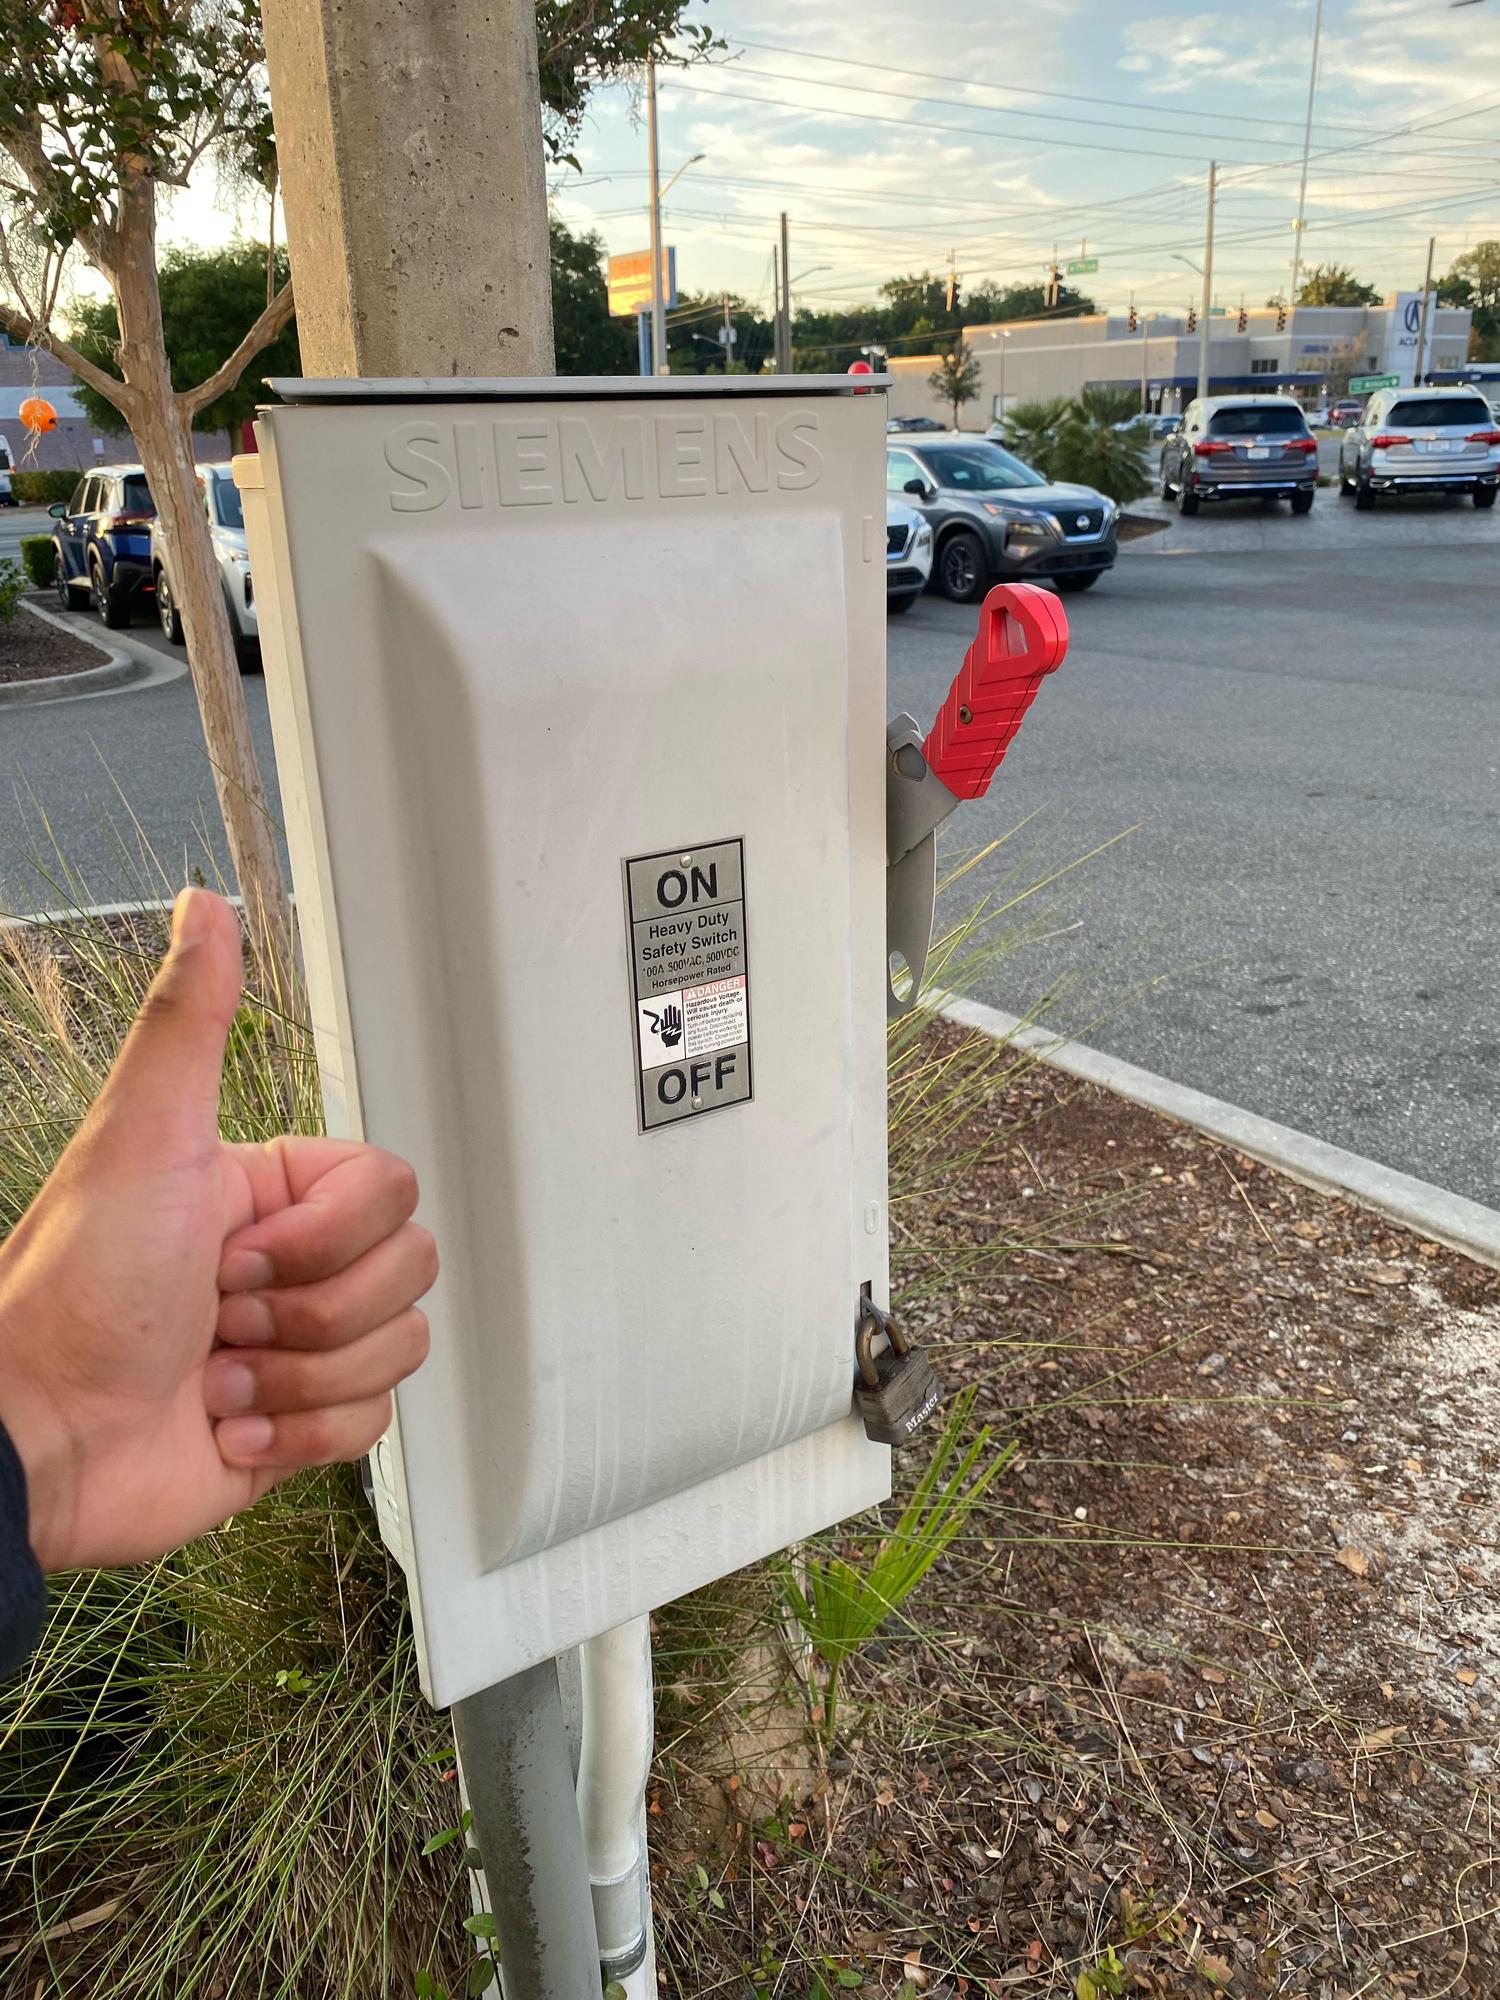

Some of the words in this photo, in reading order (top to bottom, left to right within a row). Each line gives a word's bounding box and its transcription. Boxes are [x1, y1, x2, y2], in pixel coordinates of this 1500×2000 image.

[383, 410, 824, 513] SIEMENS
[657, 862, 718, 908] ON
[649, 920, 692, 939] Heavy
[698, 912, 729, 928] Duty
[642, 941, 687, 961] Safety
[691, 928, 737, 950] Switch
[651, 972, 704, 989] Horsepower
[706, 964, 731, 976] Rated
[697, 979, 740, 996] DANGER
[686, 997, 717, 1008] Hazardous
[699, 1004, 717, 1012] cause
[719, 999, 735, 1007] death
[687, 1013, 709, 1022] serious
[658, 1053, 736, 1104] OFF
[905, 1393, 938, 1433] Master
